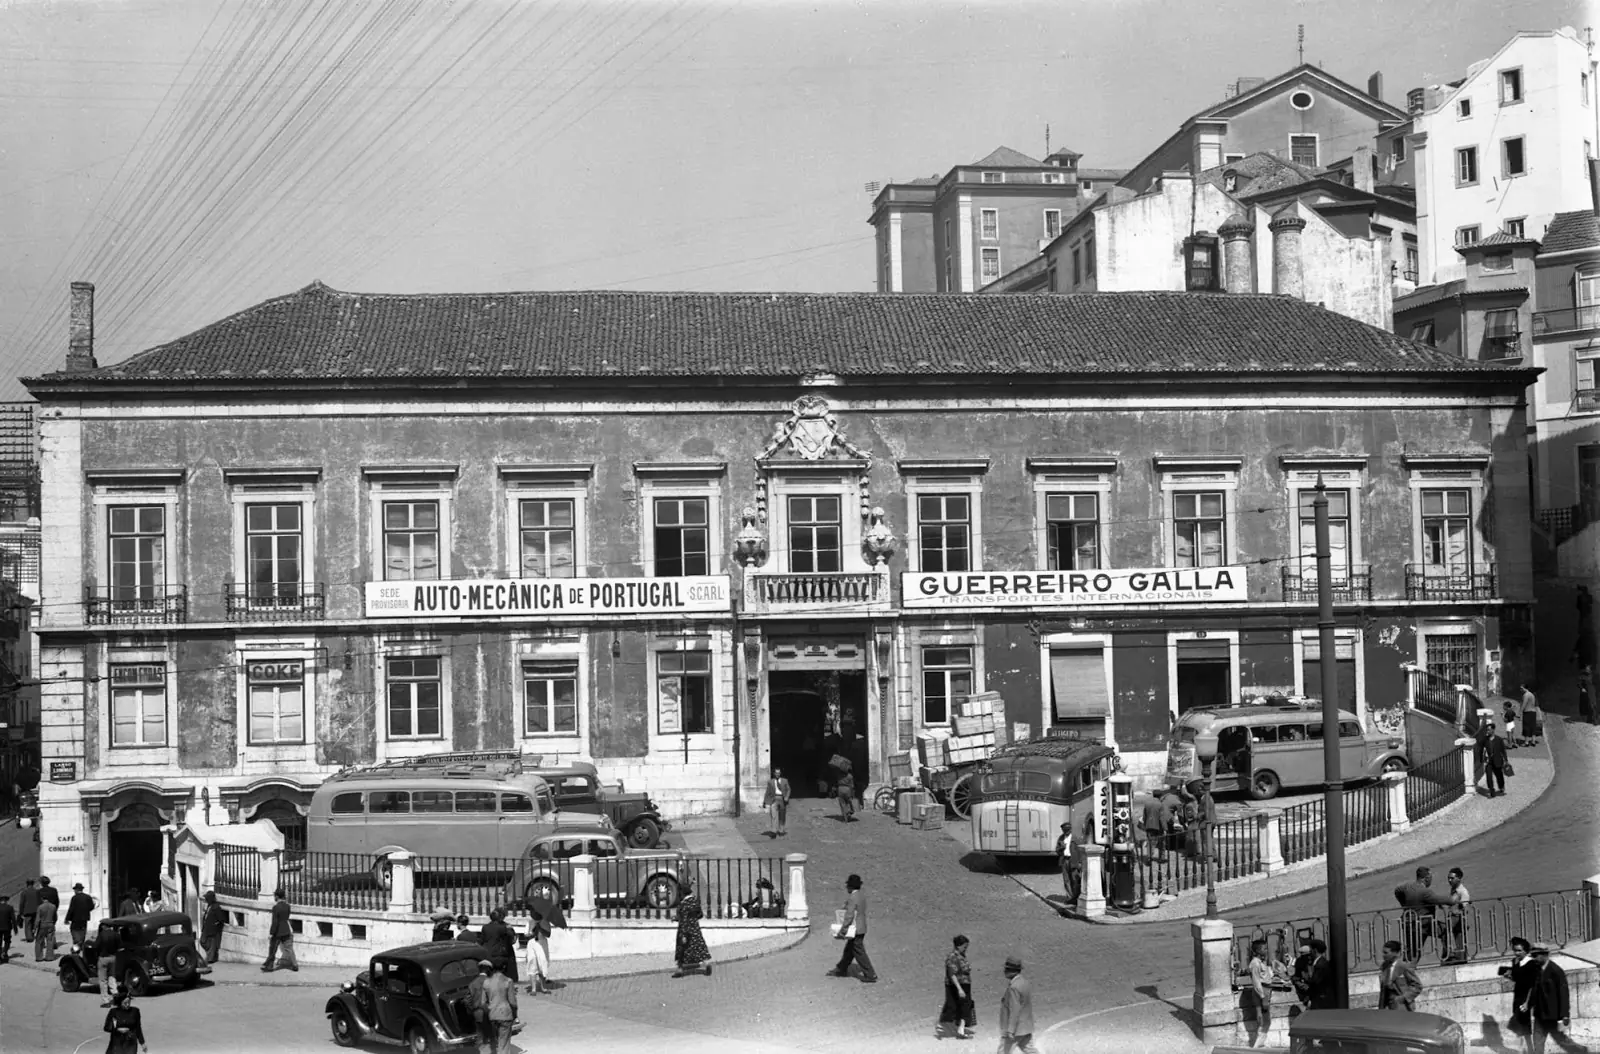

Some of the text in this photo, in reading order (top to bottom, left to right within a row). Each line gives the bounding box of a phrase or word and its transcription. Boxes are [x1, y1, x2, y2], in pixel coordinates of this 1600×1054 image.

[919, 570, 1234, 595] GUERREIRO GALLA
[379, 587, 401, 598] SEDE
[413, 581, 685, 611] AUTO-MECÂNICA DE PORTUGAL
[941, 591, 1213, 604] TRANSPORTES INTERNACIONAIS
[253, 664, 301, 680] COKE
[57, 834, 75, 842] CAFÉ
